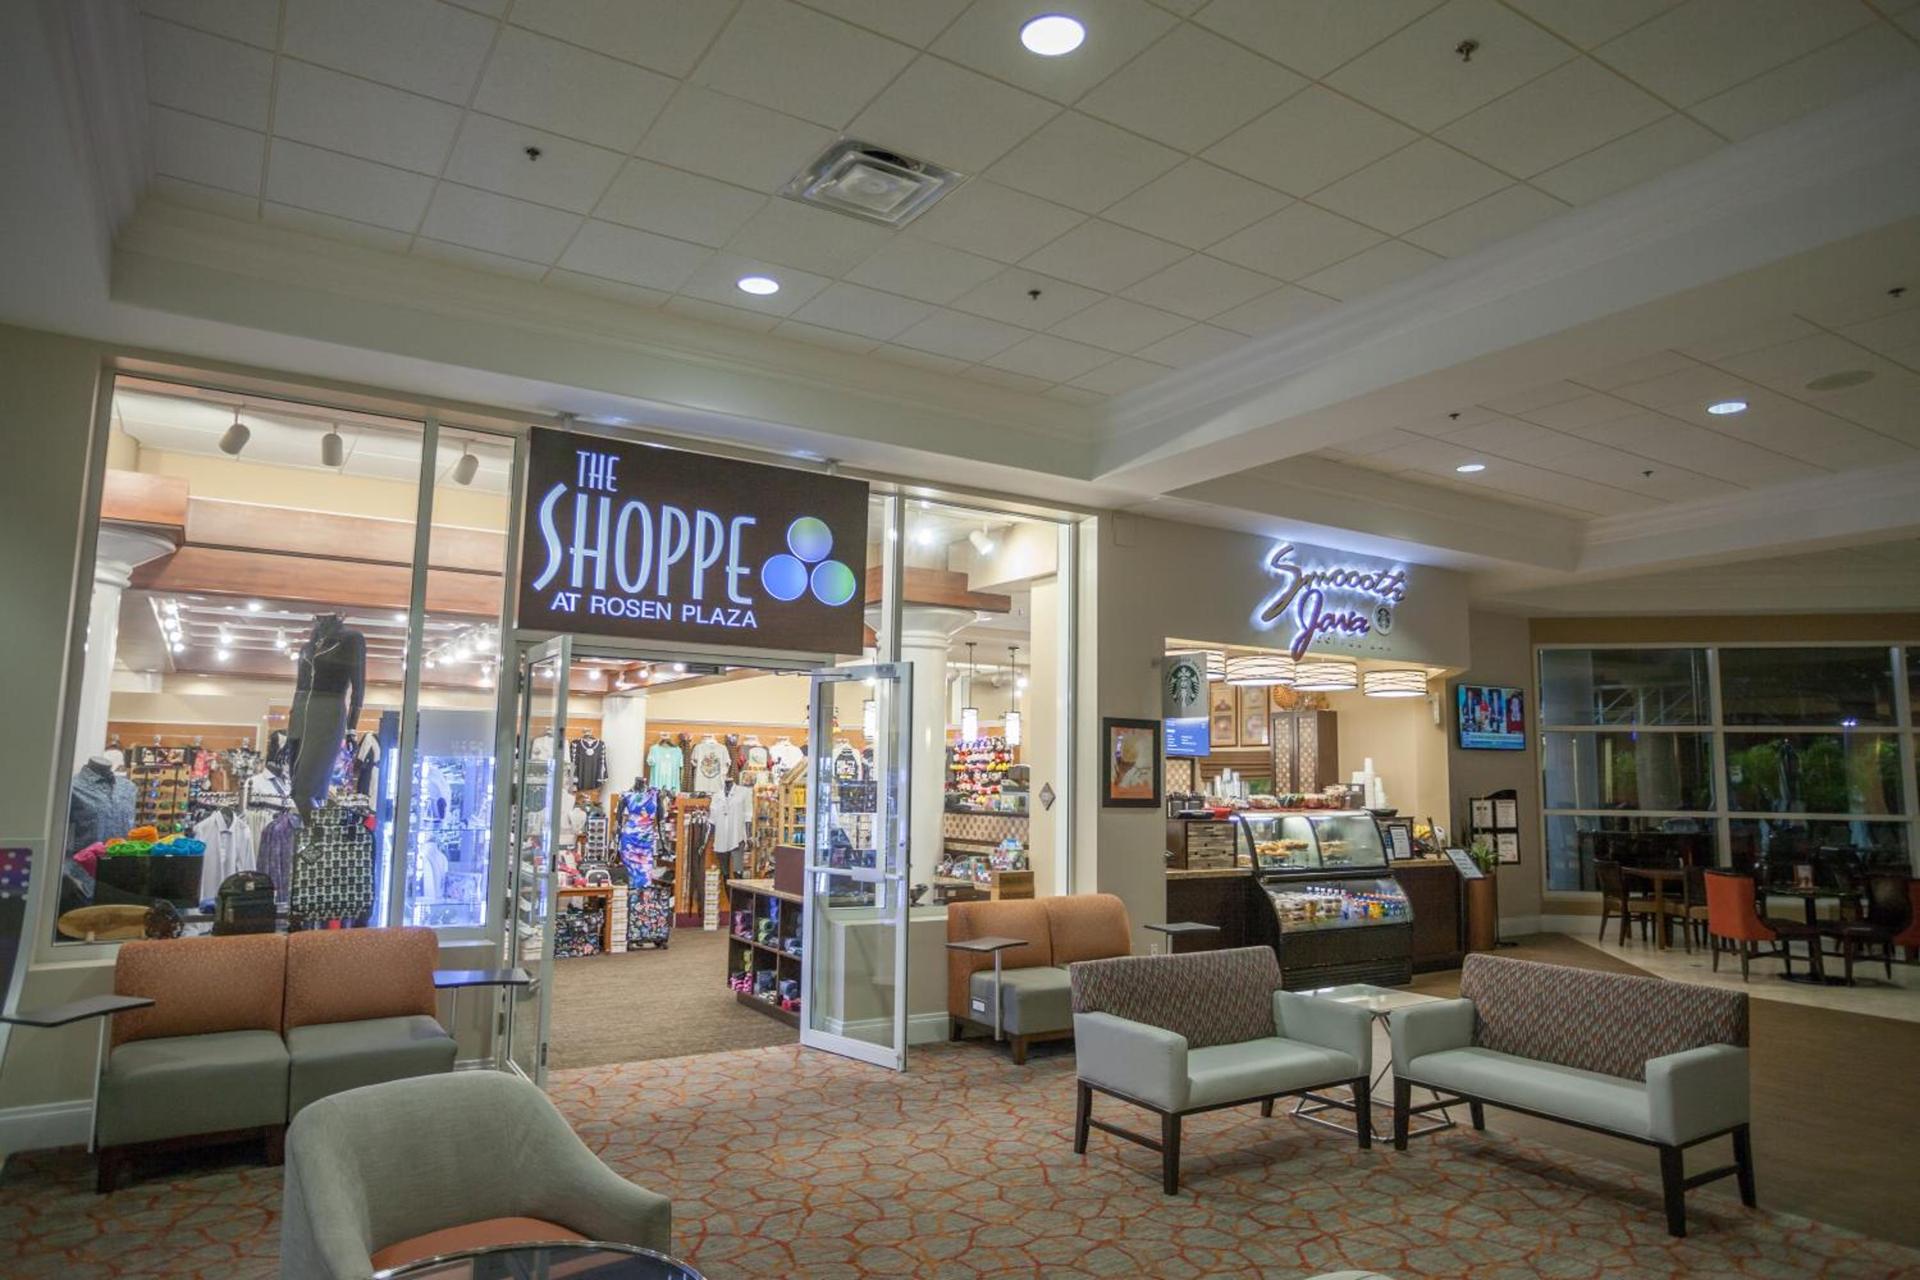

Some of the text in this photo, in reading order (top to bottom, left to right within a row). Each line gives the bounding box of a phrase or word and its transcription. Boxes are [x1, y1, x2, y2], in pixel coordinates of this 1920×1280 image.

[576, 450, 621, 493] THE
[532, 481, 757, 606] SHOPPE
[551, 592, 758, 629] AT ROSEN PLAZA
[1290, 588, 1371, 662] Java
